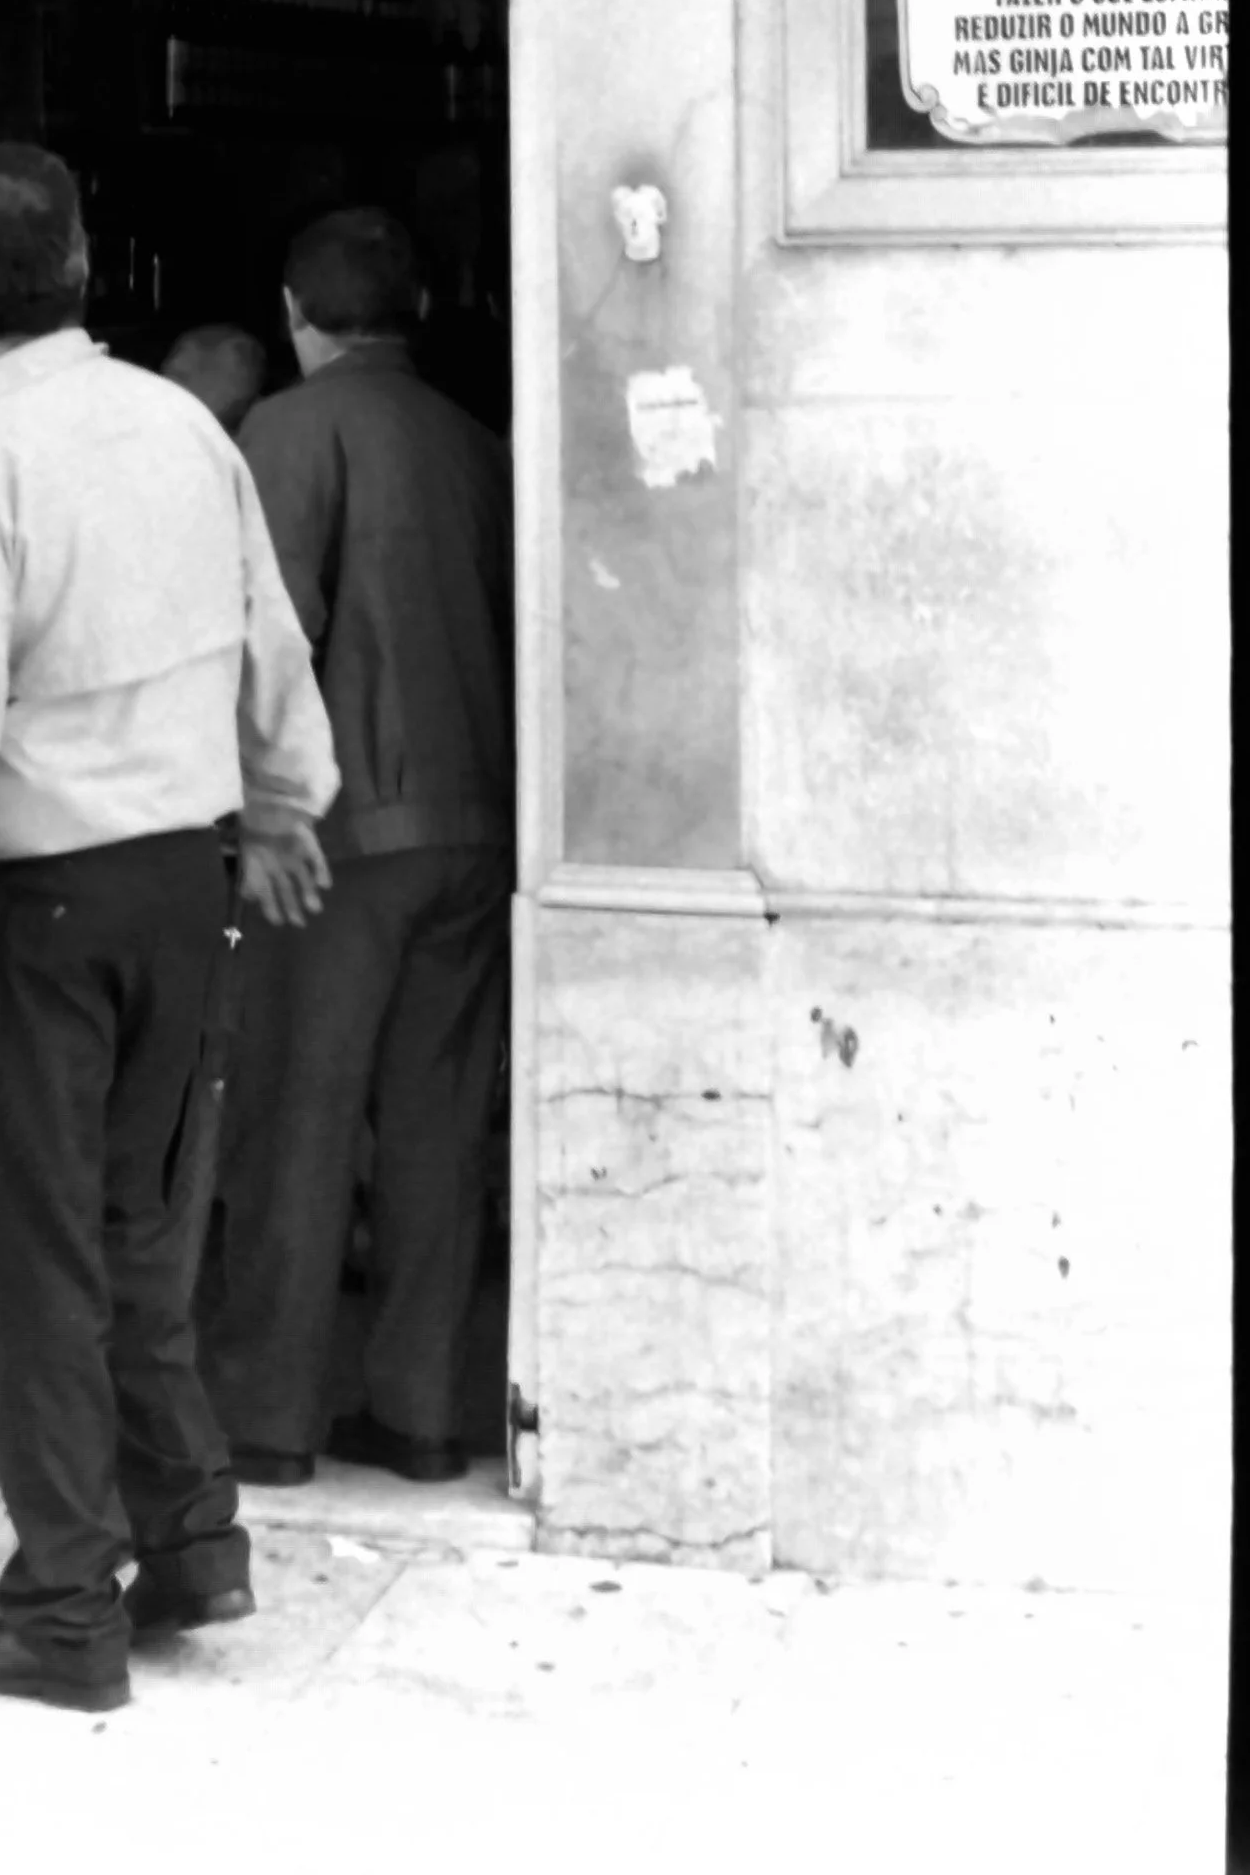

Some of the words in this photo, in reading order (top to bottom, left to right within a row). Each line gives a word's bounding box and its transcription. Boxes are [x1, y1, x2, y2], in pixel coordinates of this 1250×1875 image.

[954, 14, 1051, 41] REDUZIR
[1060, 13, 1074, 39] O
[1082, 10, 1167, 37] MUNDO
[1176, 9, 1190, 35] A
[953, 48, 1001, 76] MAS
[1010, 47, 1074, 78] GINJA
[1082, 45, 1132, 72] COM
[1140, 45, 1175, 71] TAL
[1185, 43, 1229, 70] VIR
[996, 80, 1076, 108] DIFICIL
[1083, 80, 1111, 107] DE
